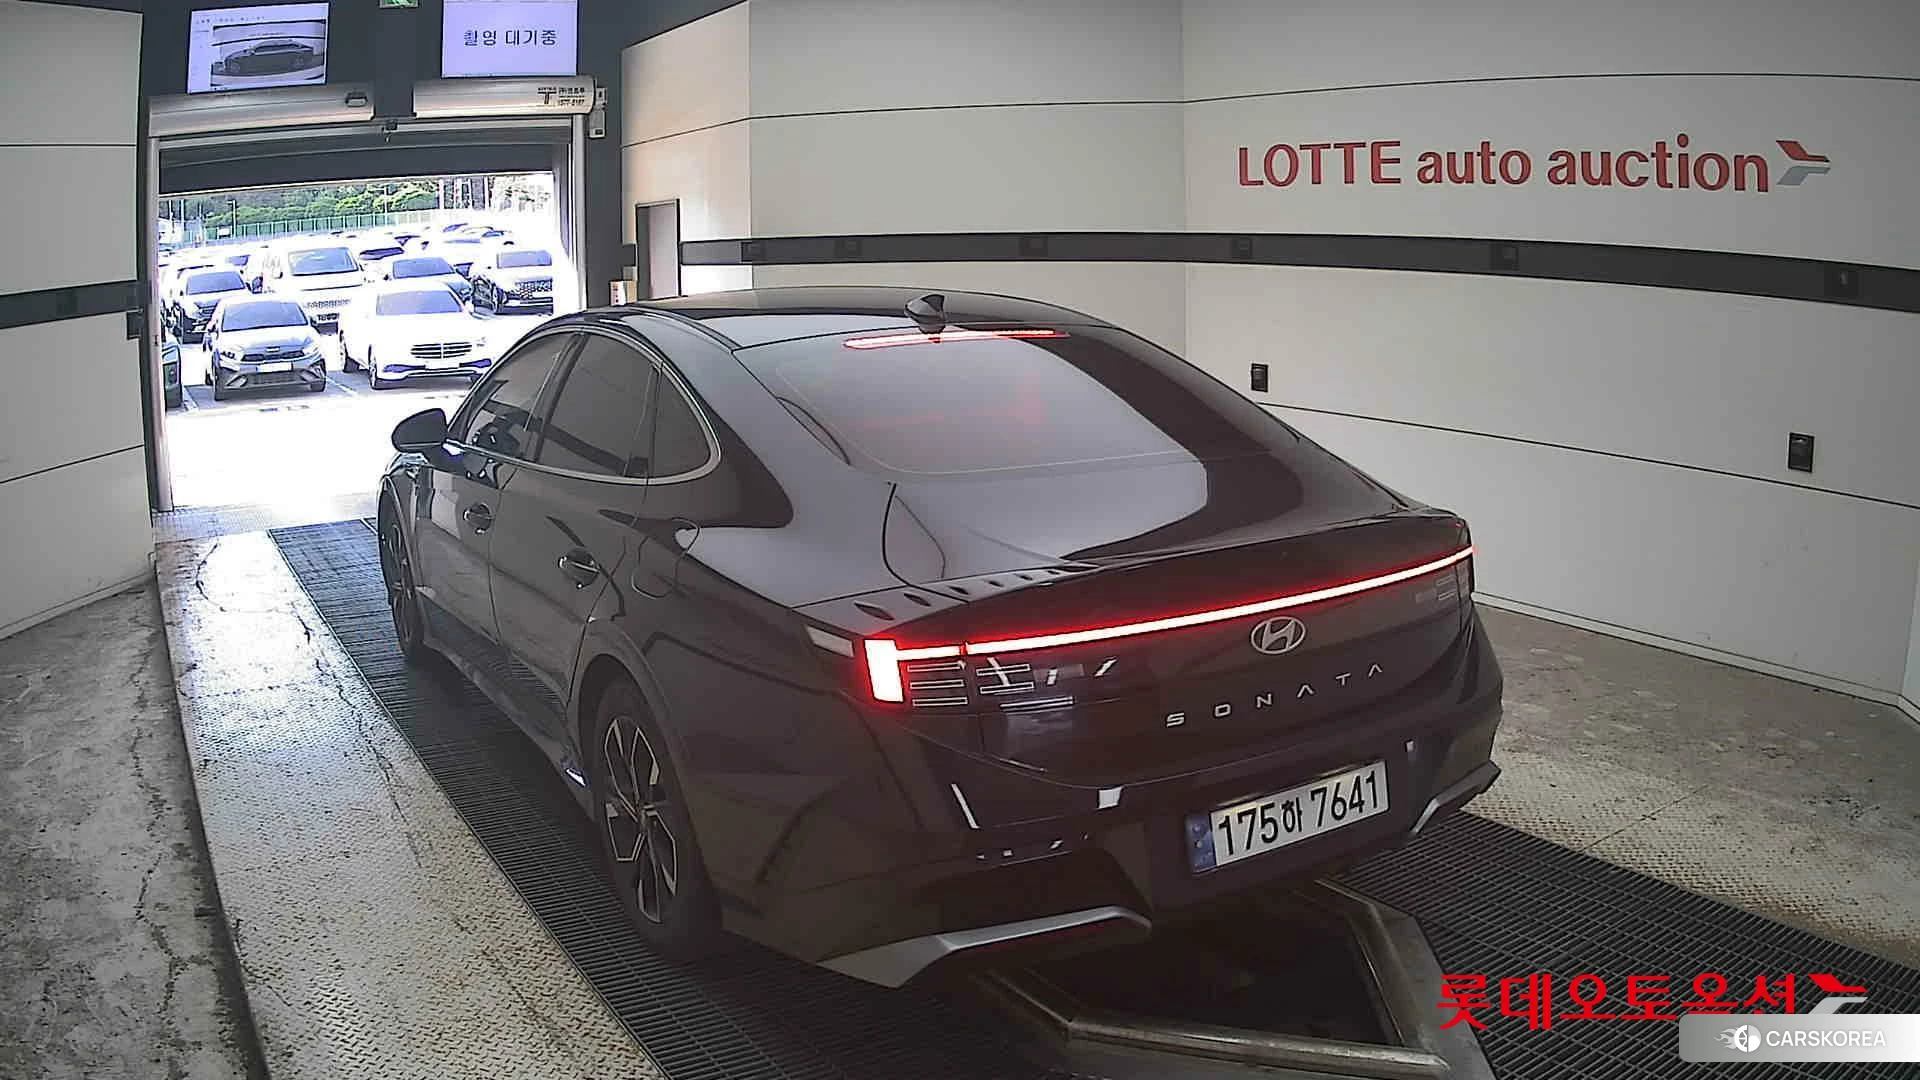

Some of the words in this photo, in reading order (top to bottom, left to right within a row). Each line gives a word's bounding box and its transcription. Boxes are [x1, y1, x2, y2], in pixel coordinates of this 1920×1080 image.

[505, 29, 557, 46] 대기중
[1238, 140, 1401, 187] LOTTE
[1416, 140, 1532, 185] auto
[1547, 133, 1769, 193] auction
[1166, 663, 1383, 727] SONATA
[1218, 797, 1303, 856] 175하
[1310, 770, 1379, 828] 7641
